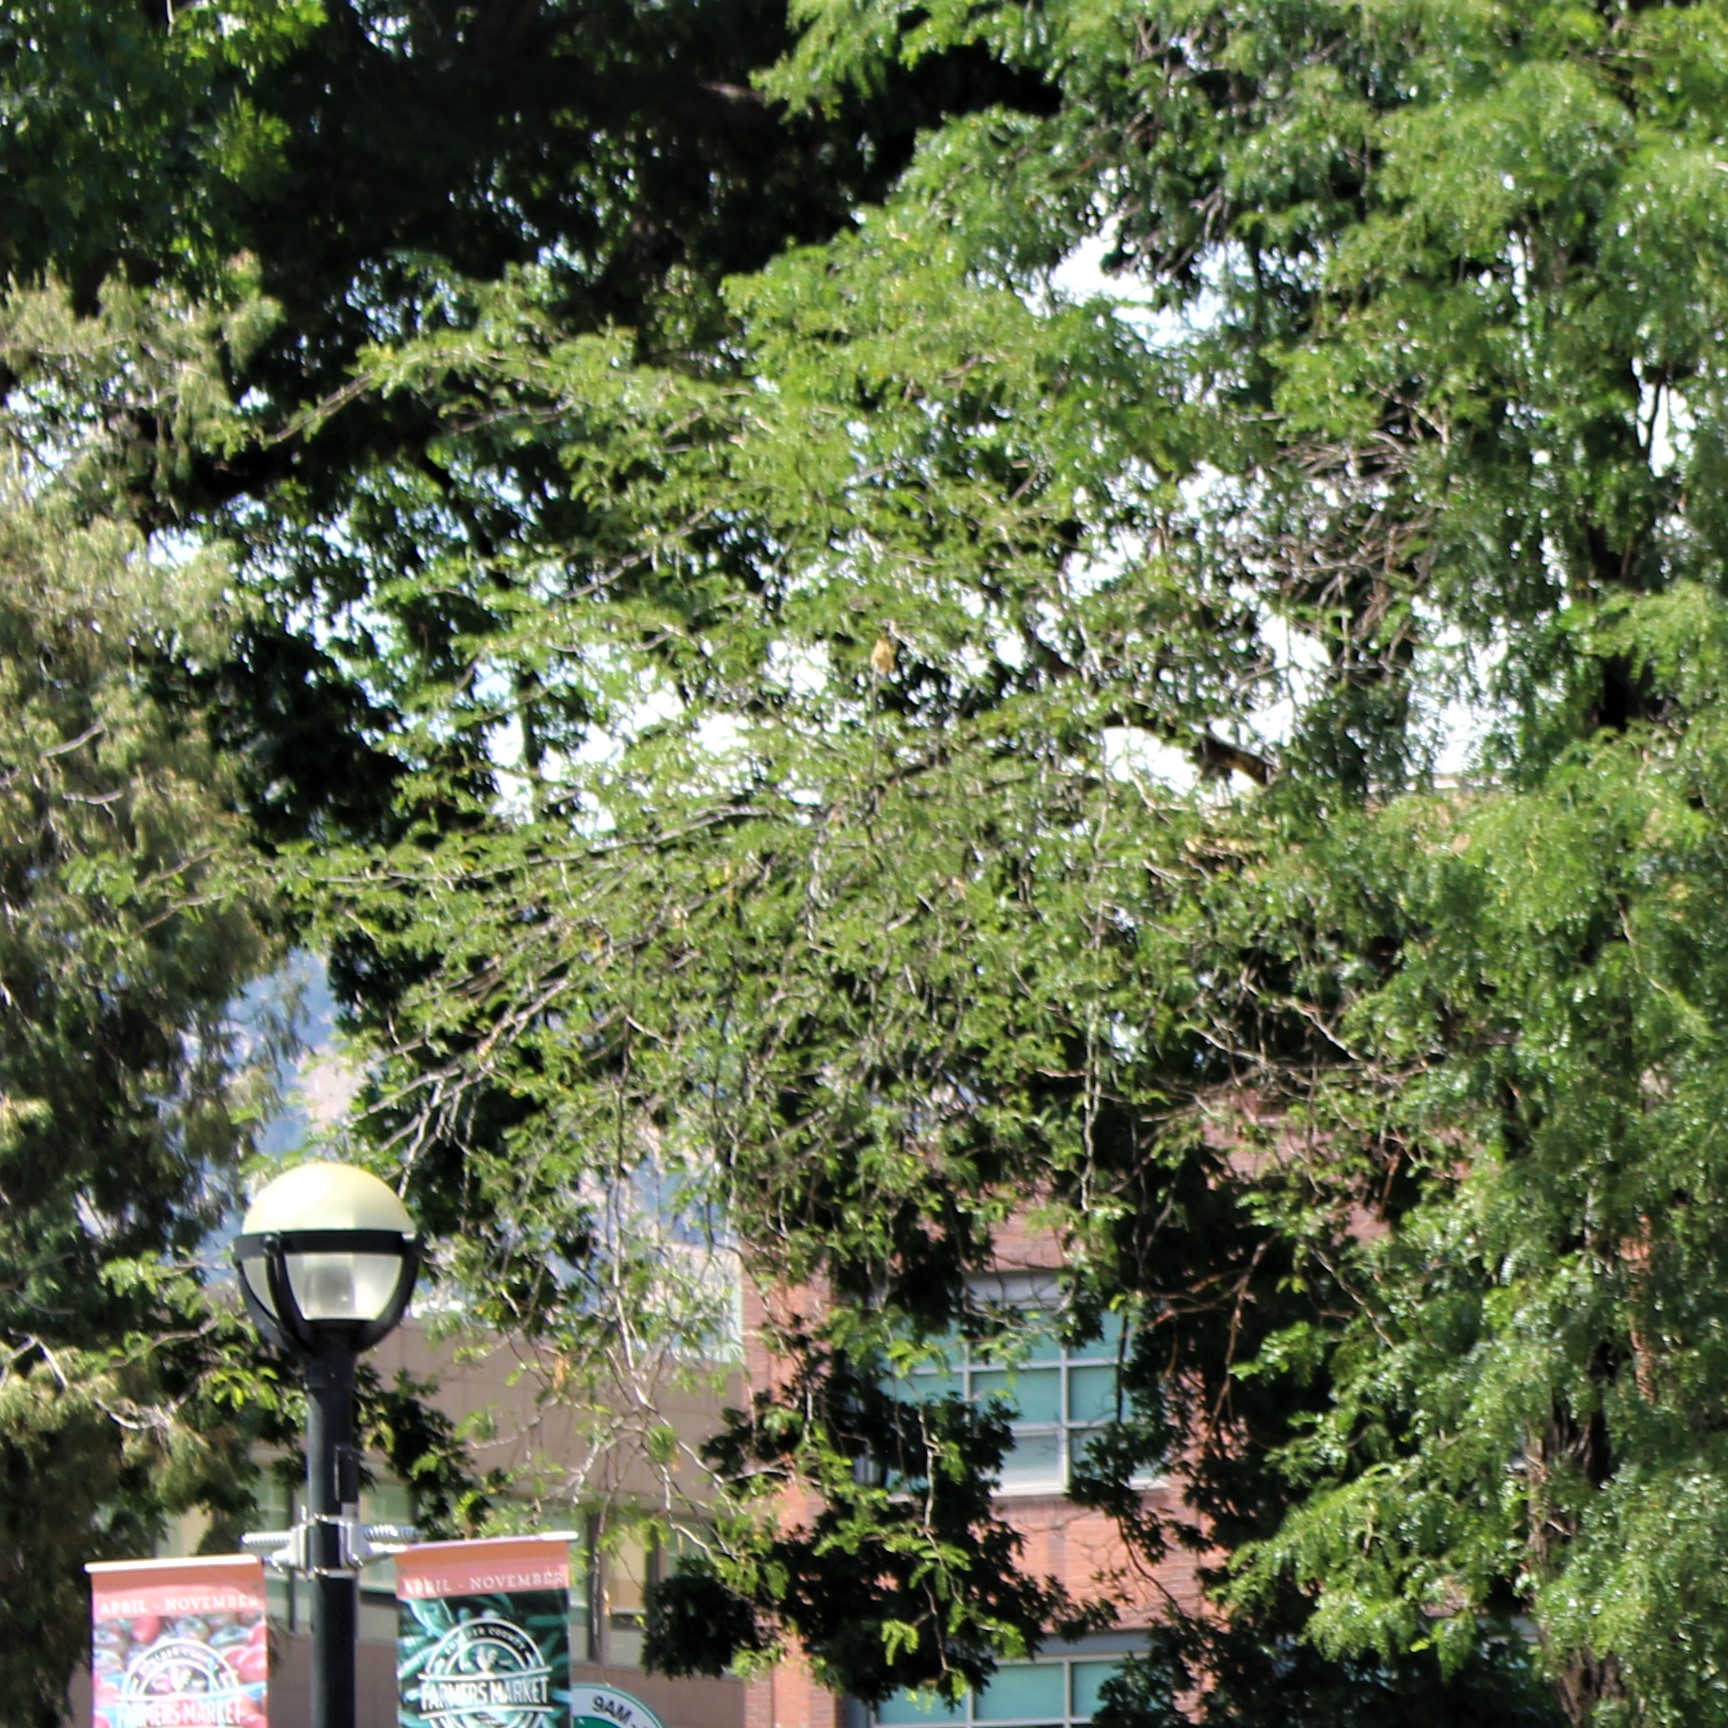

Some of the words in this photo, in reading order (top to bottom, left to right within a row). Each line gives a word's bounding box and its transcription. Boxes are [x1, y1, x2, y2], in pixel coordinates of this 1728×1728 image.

[400, 1576, 452, 1595] APRIL
[469, 1571, 564, 1590] NOVEMBER
[101, 1599, 149, 1616] APRIL
[165, 1594, 259, 1613] NOVEMBER
[420, 1681, 487, 1711] FARMERS
[490, 1675, 550, 1704] MARKET
[592, 1695, 633, 1725] 9AM
